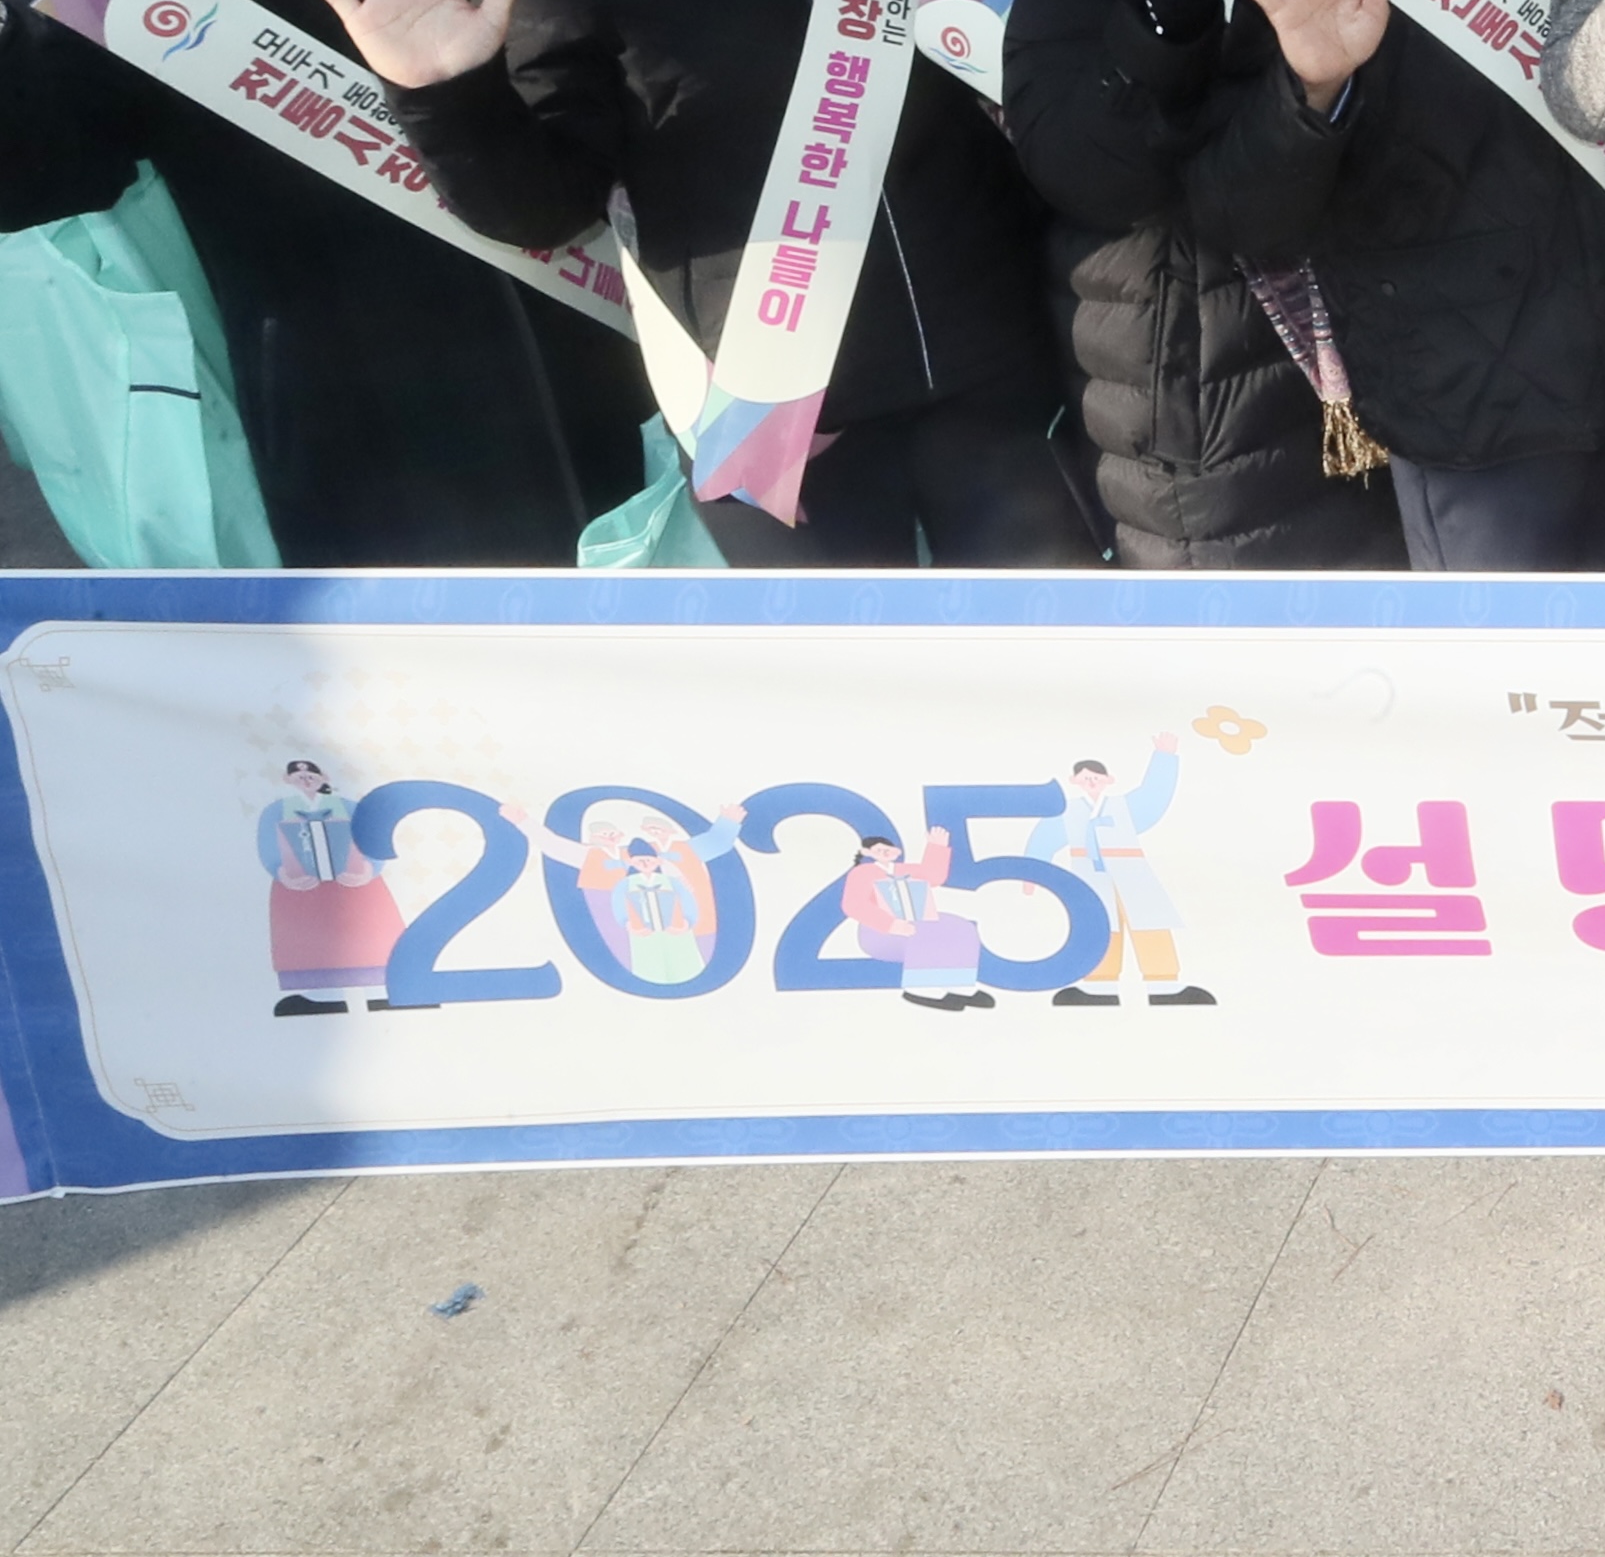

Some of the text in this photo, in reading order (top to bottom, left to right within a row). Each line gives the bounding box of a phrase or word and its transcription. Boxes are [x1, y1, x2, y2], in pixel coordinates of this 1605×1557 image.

[252, 27, 345, 90] 모두가
[798, 50, 871, 189] 행복한
[757, 199, 832, 333] 나들이
[350, 779, 1111, 1004] 2025
[1284, 799, 1493, 958] 설
